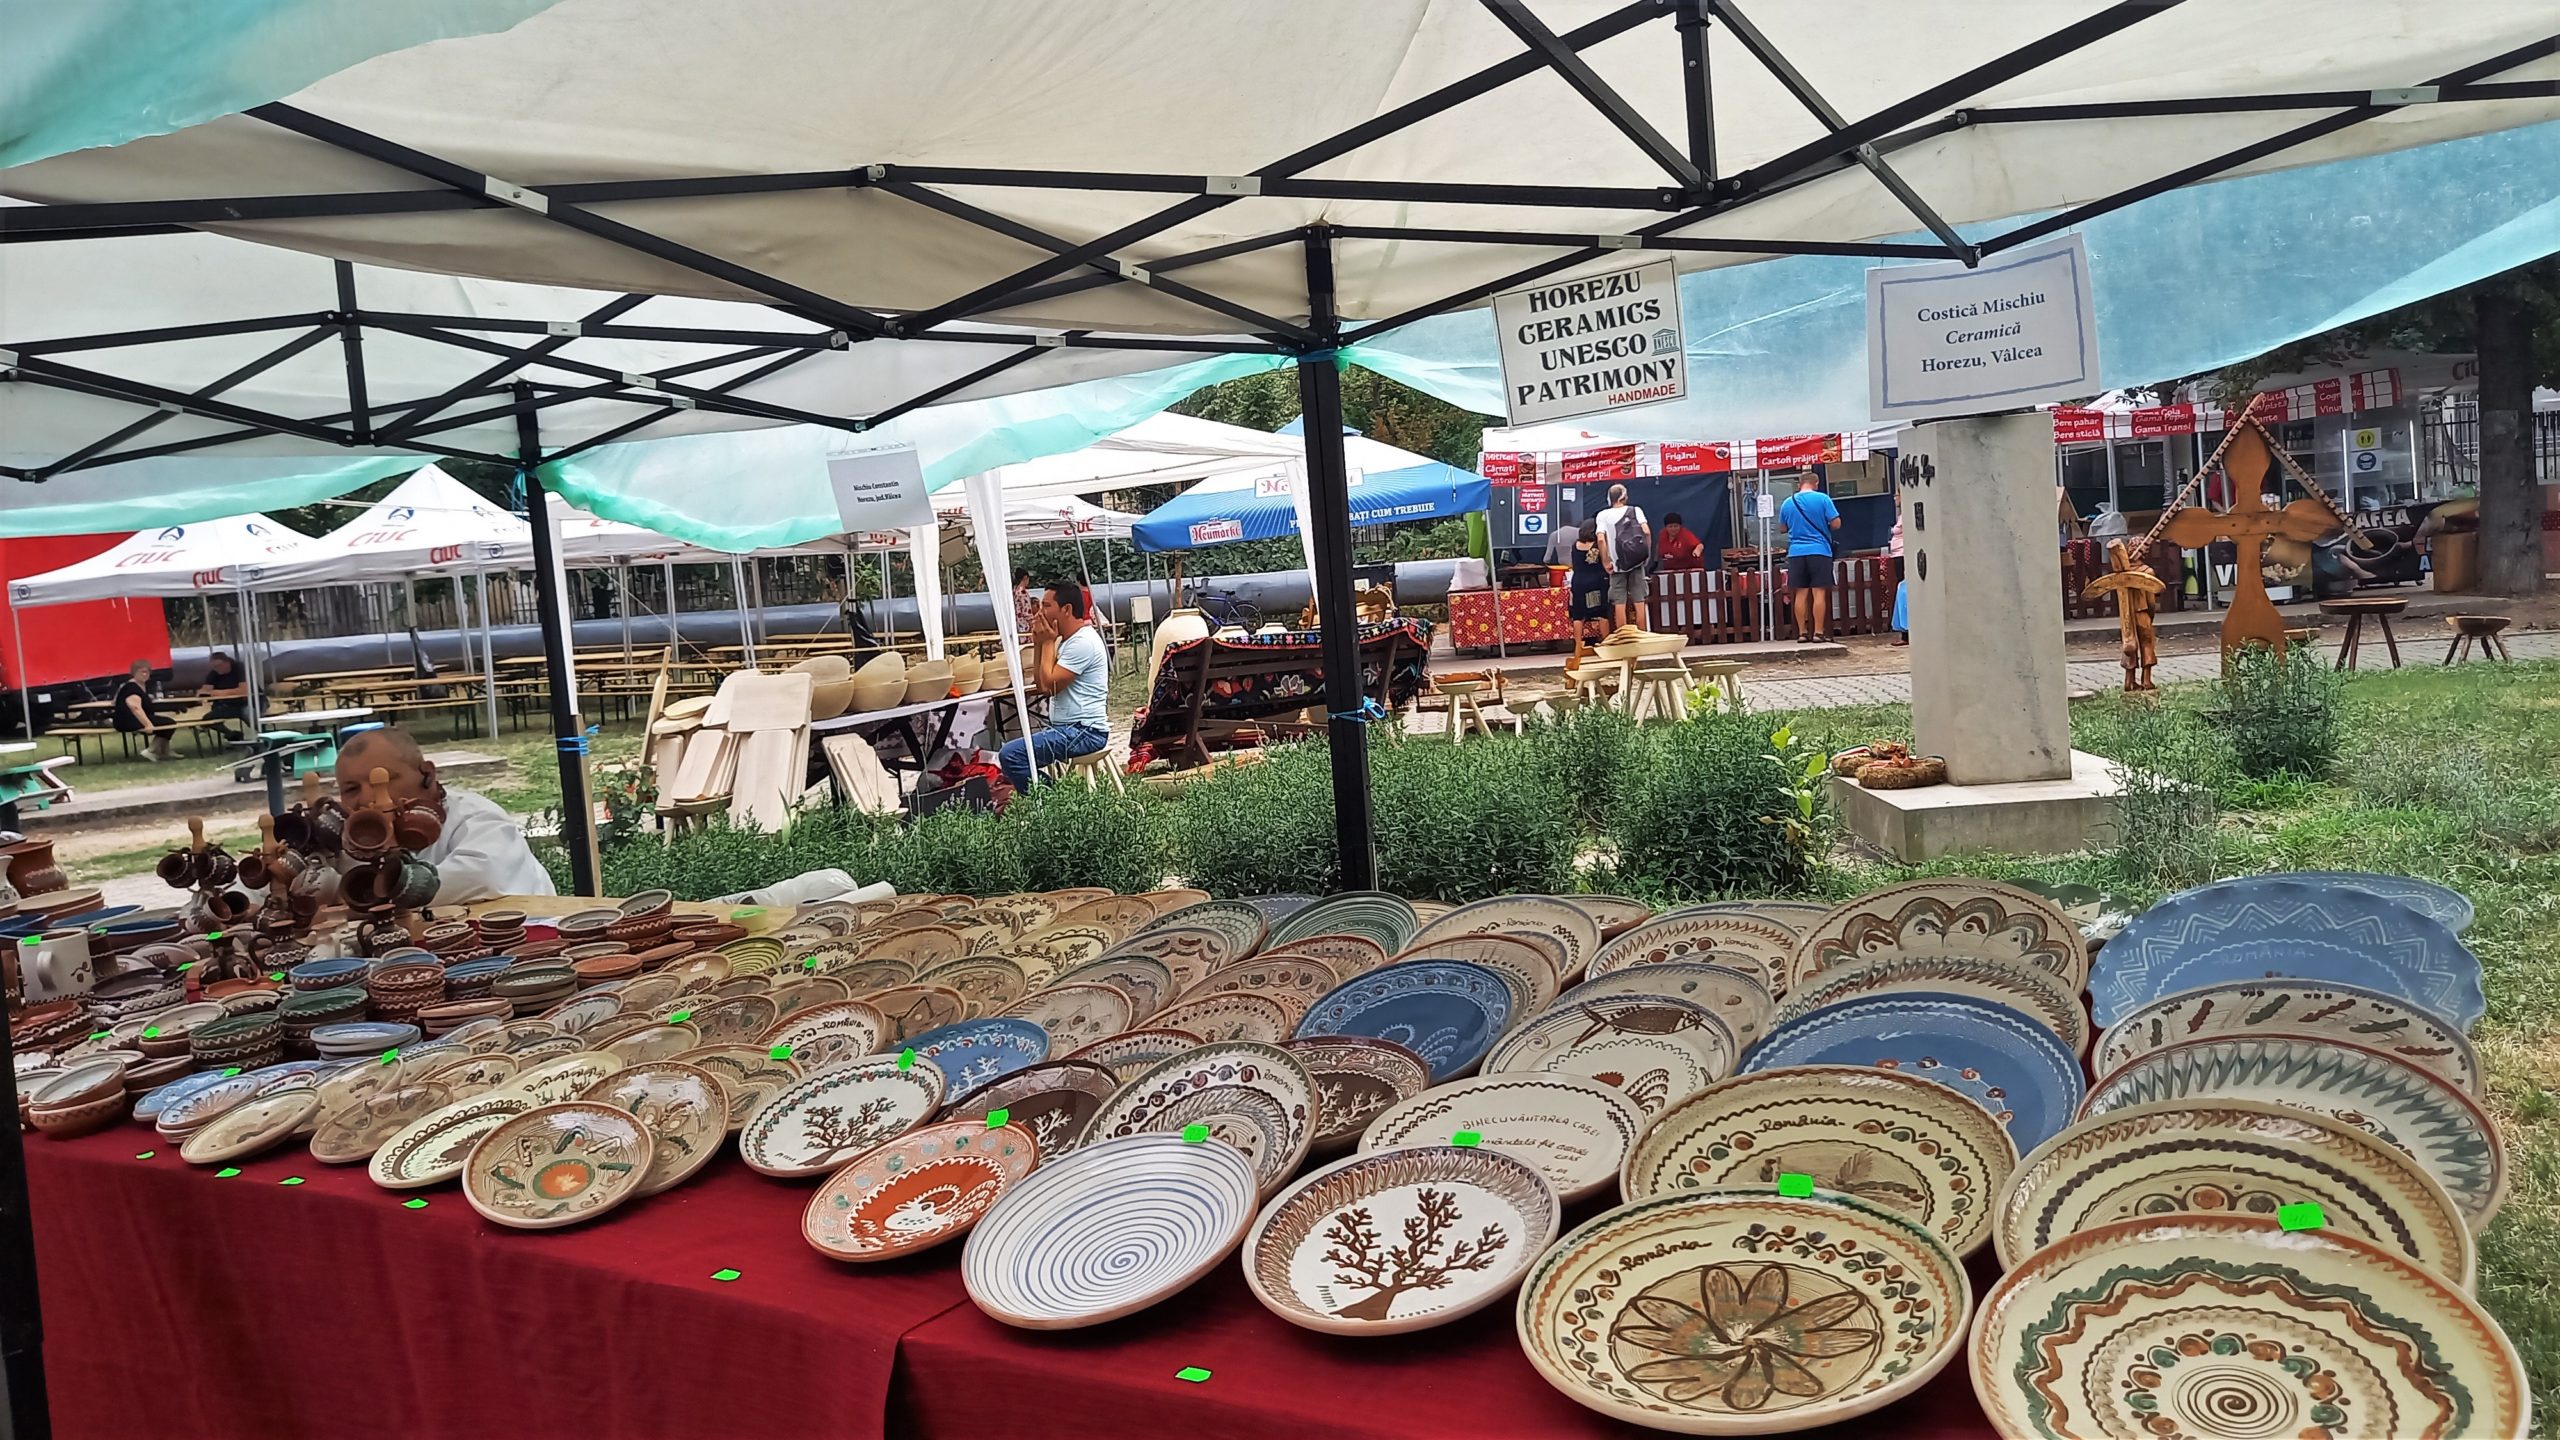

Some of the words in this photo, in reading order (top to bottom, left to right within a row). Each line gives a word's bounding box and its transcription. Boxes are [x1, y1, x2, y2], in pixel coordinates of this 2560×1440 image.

[1528, 270, 1641, 314] HOREZU
[1917, 303, 1978, 322] Costică
[1982, 291, 2046, 315] Mischiu
[1518, 298, 1661, 345] CERAMICS
[1945, 321, 2022, 345] Ceramică
[1540, 333, 1647, 371] UNESCO
[1921, 356, 1987, 373] Horezu,
[1991, 346, 2043, 364] Vâlcea
[1517, 357, 1676, 406] PATRIMONY
[1607, 383, 1677, 406] HANDMADE
[2074, 418, 2100, 428] pahar
[1666, 462, 1701, 473] Sarmale
[1371, 508, 1392, 519] CUM
[1394, 502, 1435, 515] TREBUIE
[2353, 508, 2412, 530] AFEA
